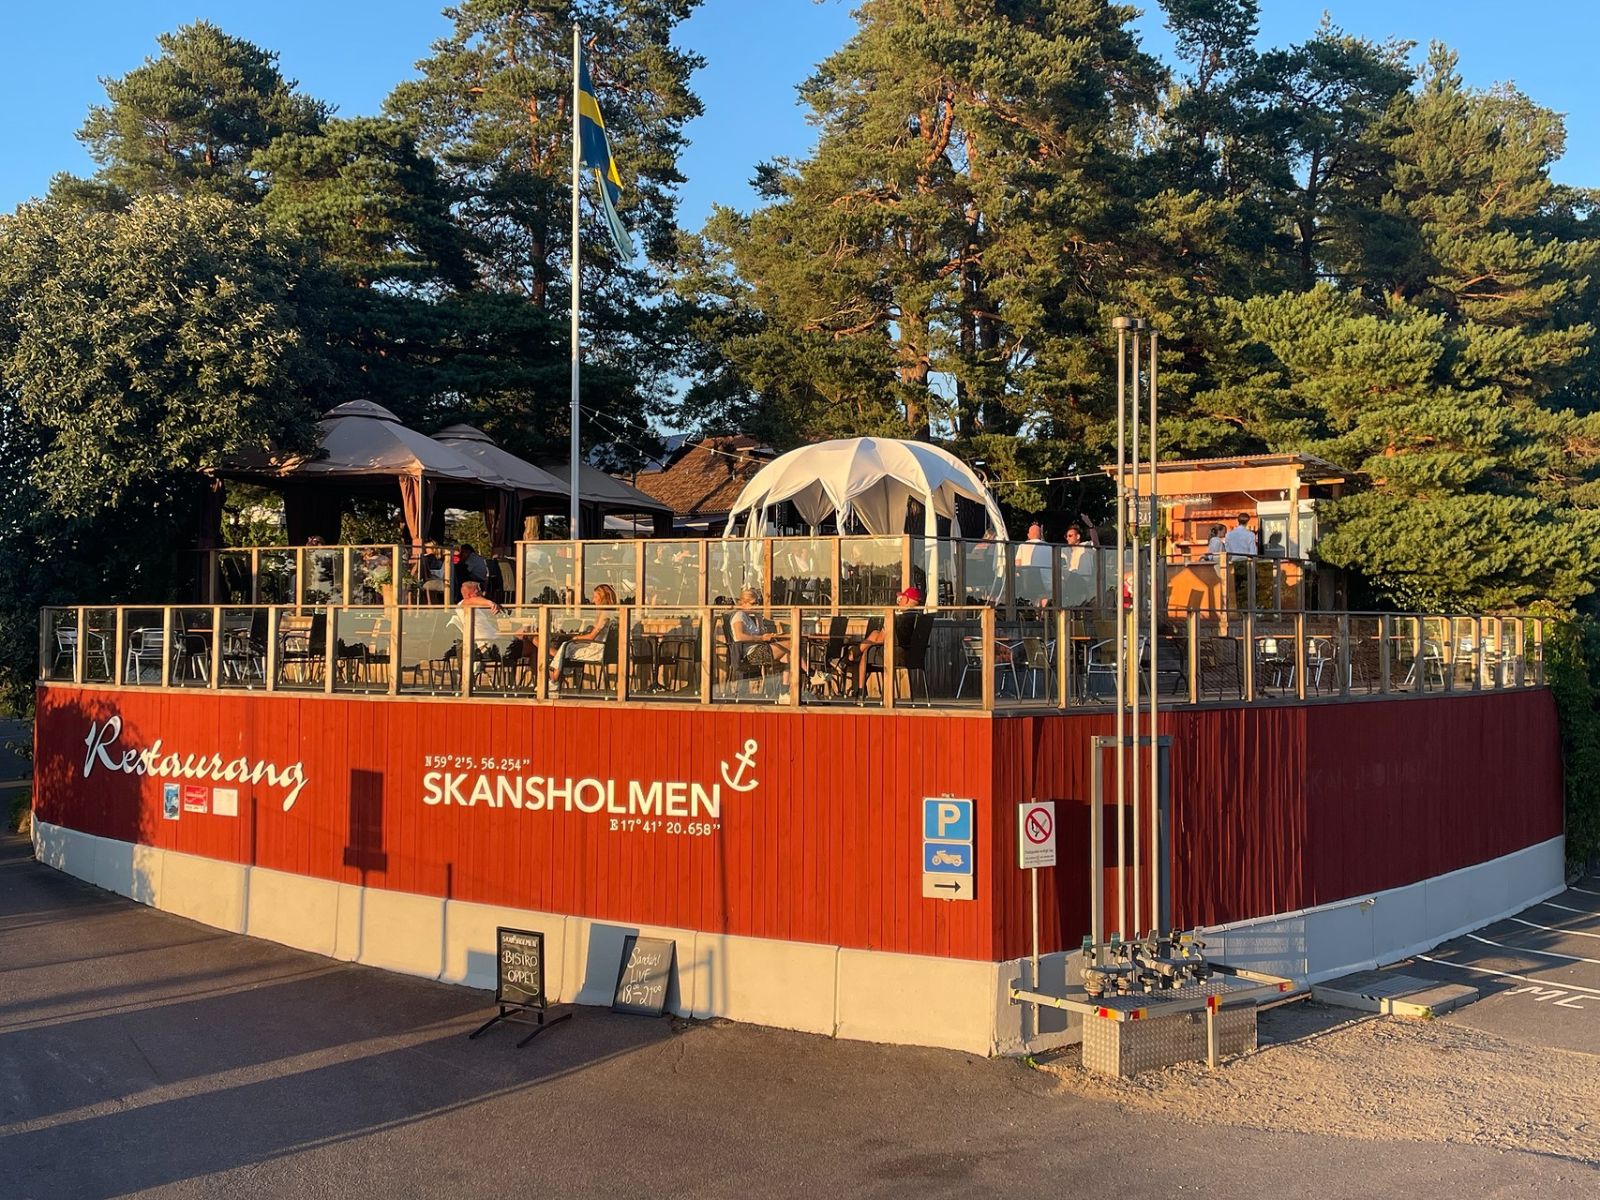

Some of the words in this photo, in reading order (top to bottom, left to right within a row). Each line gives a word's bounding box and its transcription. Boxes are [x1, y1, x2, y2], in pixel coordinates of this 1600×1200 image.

[84, 716, 309, 812] Restaurang
[423, 772, 720, 818] SKANSHOLMEN
[938, 803, 961, 836] P
[502, 950, 538, 967] BISTRO
[630, 968, 651, 984] LIVE
